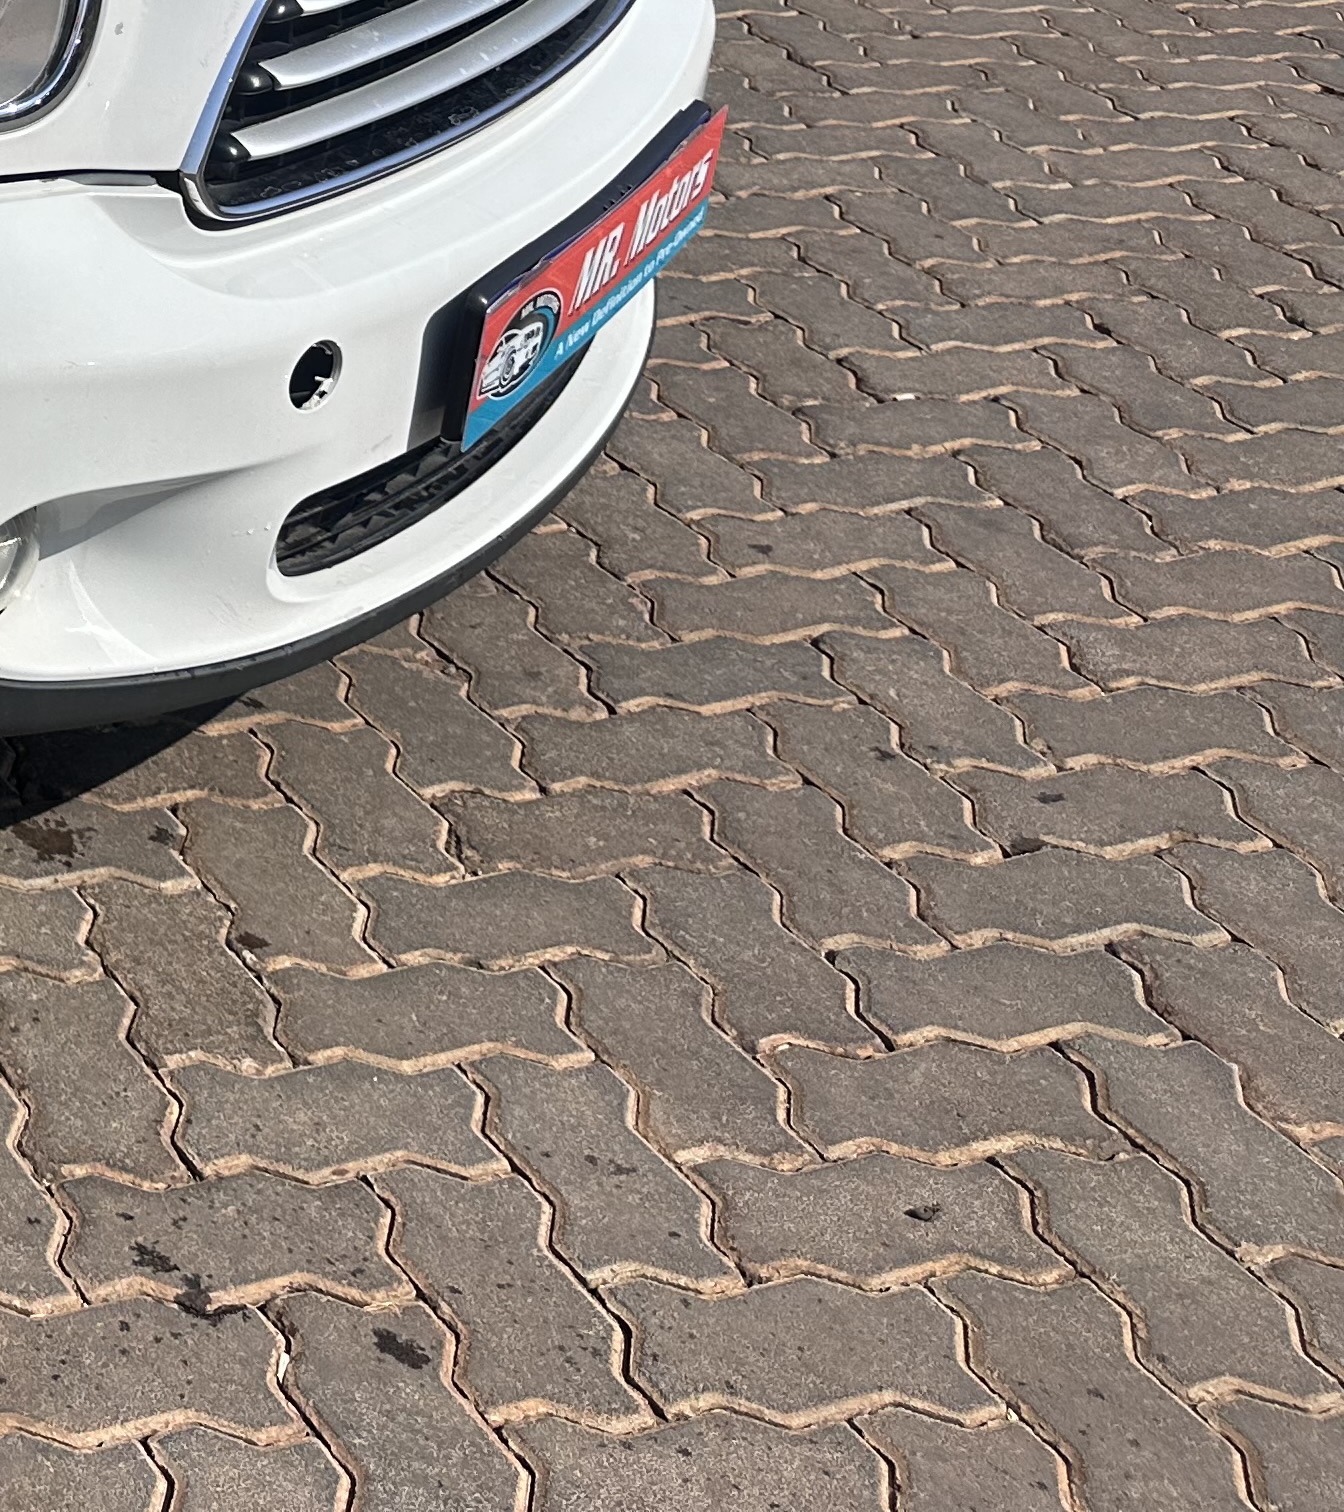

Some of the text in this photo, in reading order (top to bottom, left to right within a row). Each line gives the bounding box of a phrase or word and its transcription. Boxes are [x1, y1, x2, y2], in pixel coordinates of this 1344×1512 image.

[568, 148, 714, 317] MR. Motors
[554, 341, 565, 361] A
[565, 319, 591, 350] New
[591, 271, 643, 327] Definition
[643, 259, 655, 278] to
